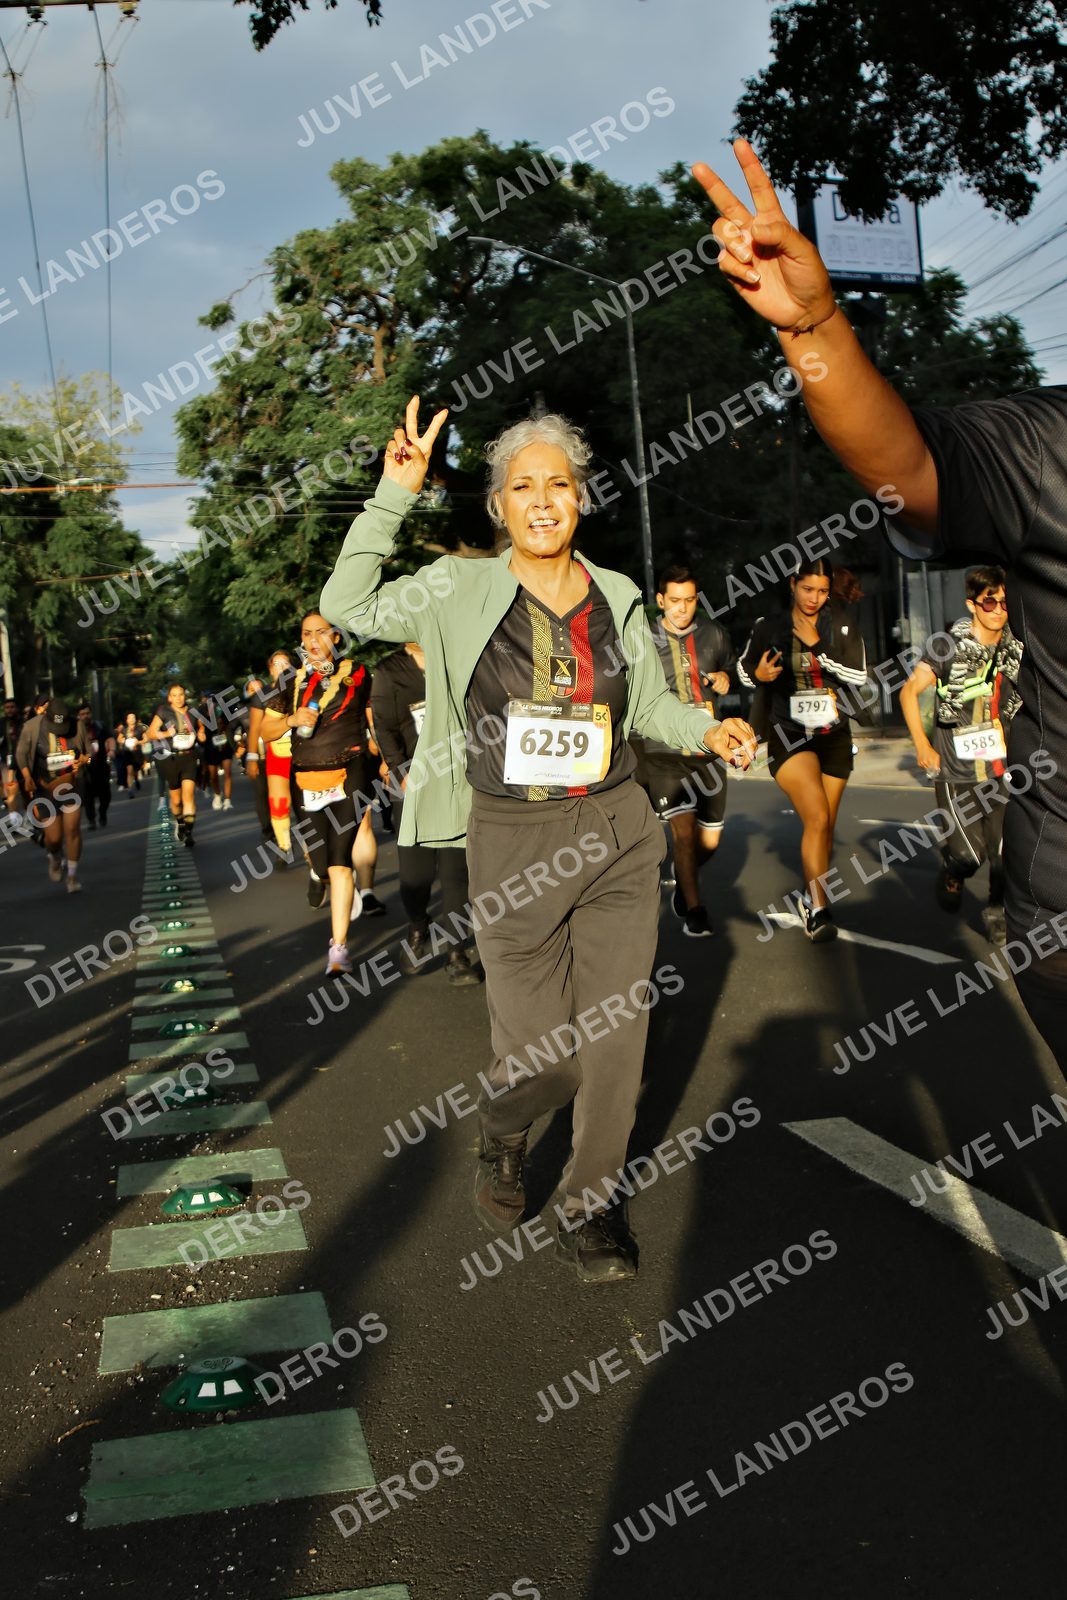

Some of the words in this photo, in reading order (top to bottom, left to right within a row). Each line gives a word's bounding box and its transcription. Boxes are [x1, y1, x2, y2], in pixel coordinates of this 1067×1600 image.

[798, 700, 828, 713] 5797
[595, 711, 608, 722] 5K
[519, 728, 590, 758] 6259
[963, 735, 995, 752] 5585
